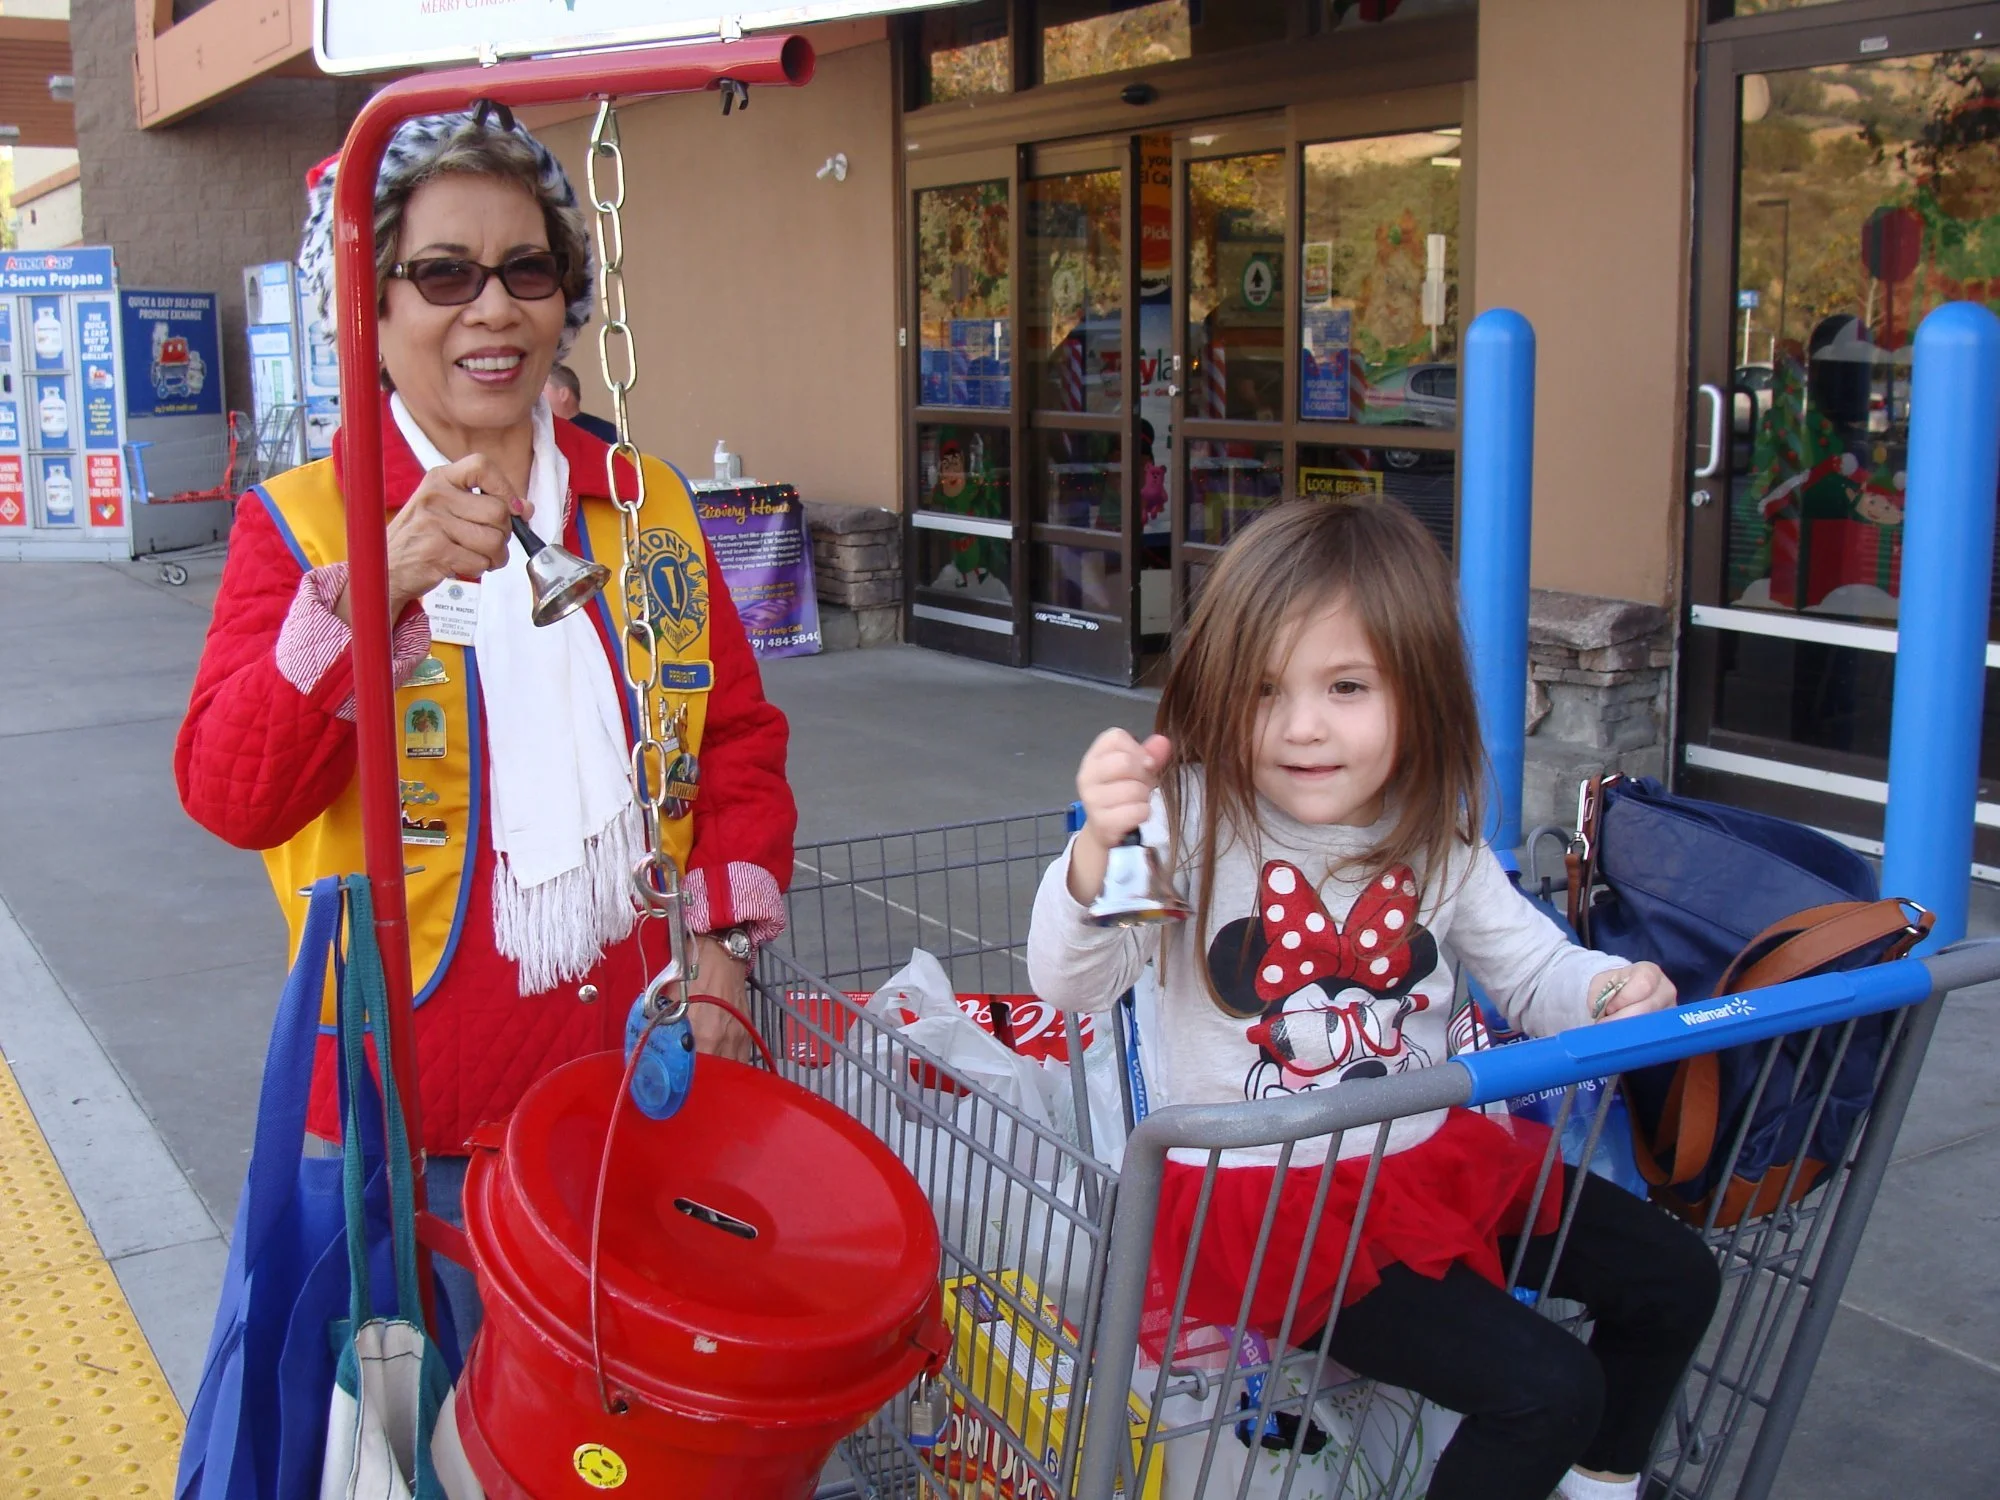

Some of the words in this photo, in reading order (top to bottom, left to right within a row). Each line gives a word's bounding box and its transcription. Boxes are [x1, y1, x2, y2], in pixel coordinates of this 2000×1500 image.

[420, 0, 461, 16] MERRY
[49, 272, 104, 288] Propane
[1306, 477, 1333, 491] LOOK
[1335, 479, 1375, 493] BEFORE
[1679, 1003, 1736, 1026] Walmart
